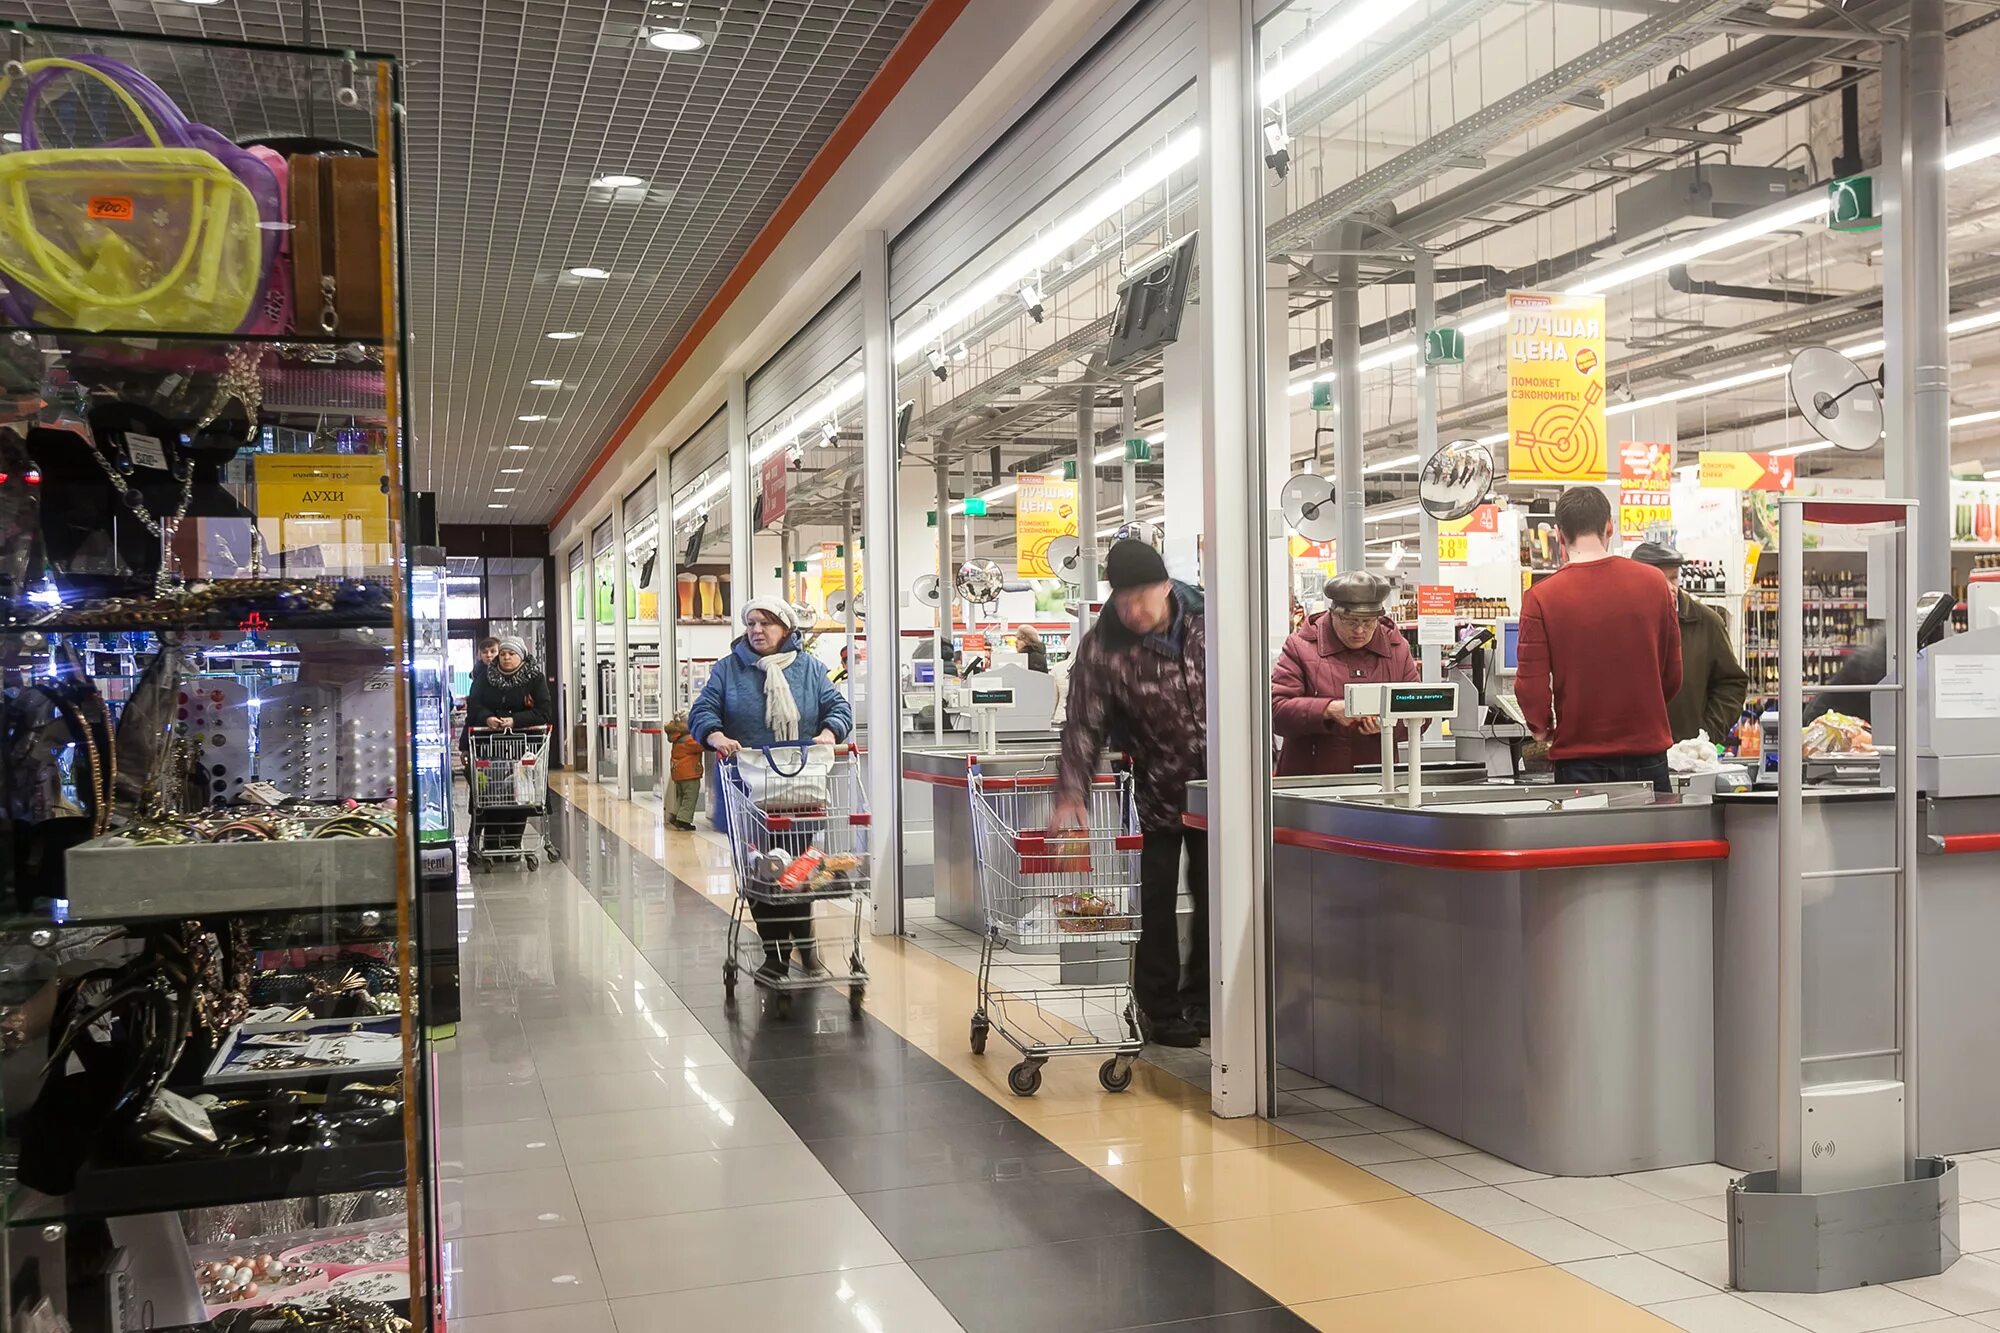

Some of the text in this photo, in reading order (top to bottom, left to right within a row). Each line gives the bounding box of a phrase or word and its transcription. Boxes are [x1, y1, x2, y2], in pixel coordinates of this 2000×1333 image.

[1512, 315, 1600, 339] ЛУЧШАЯ
[1512, 340, 1569, 363] ЦЕНА
[1511, 376, 1560, 388] ПОМОЖЕТ
[1511, 389, 1580, 401] СЭКОНОМИТЬ!
[302, 490, 345, 503] ДУХИ
[1019, 487, 1074, 499] ЛУЧШАЯ
[1019, 499, 1055, 513] ЦЕНА
